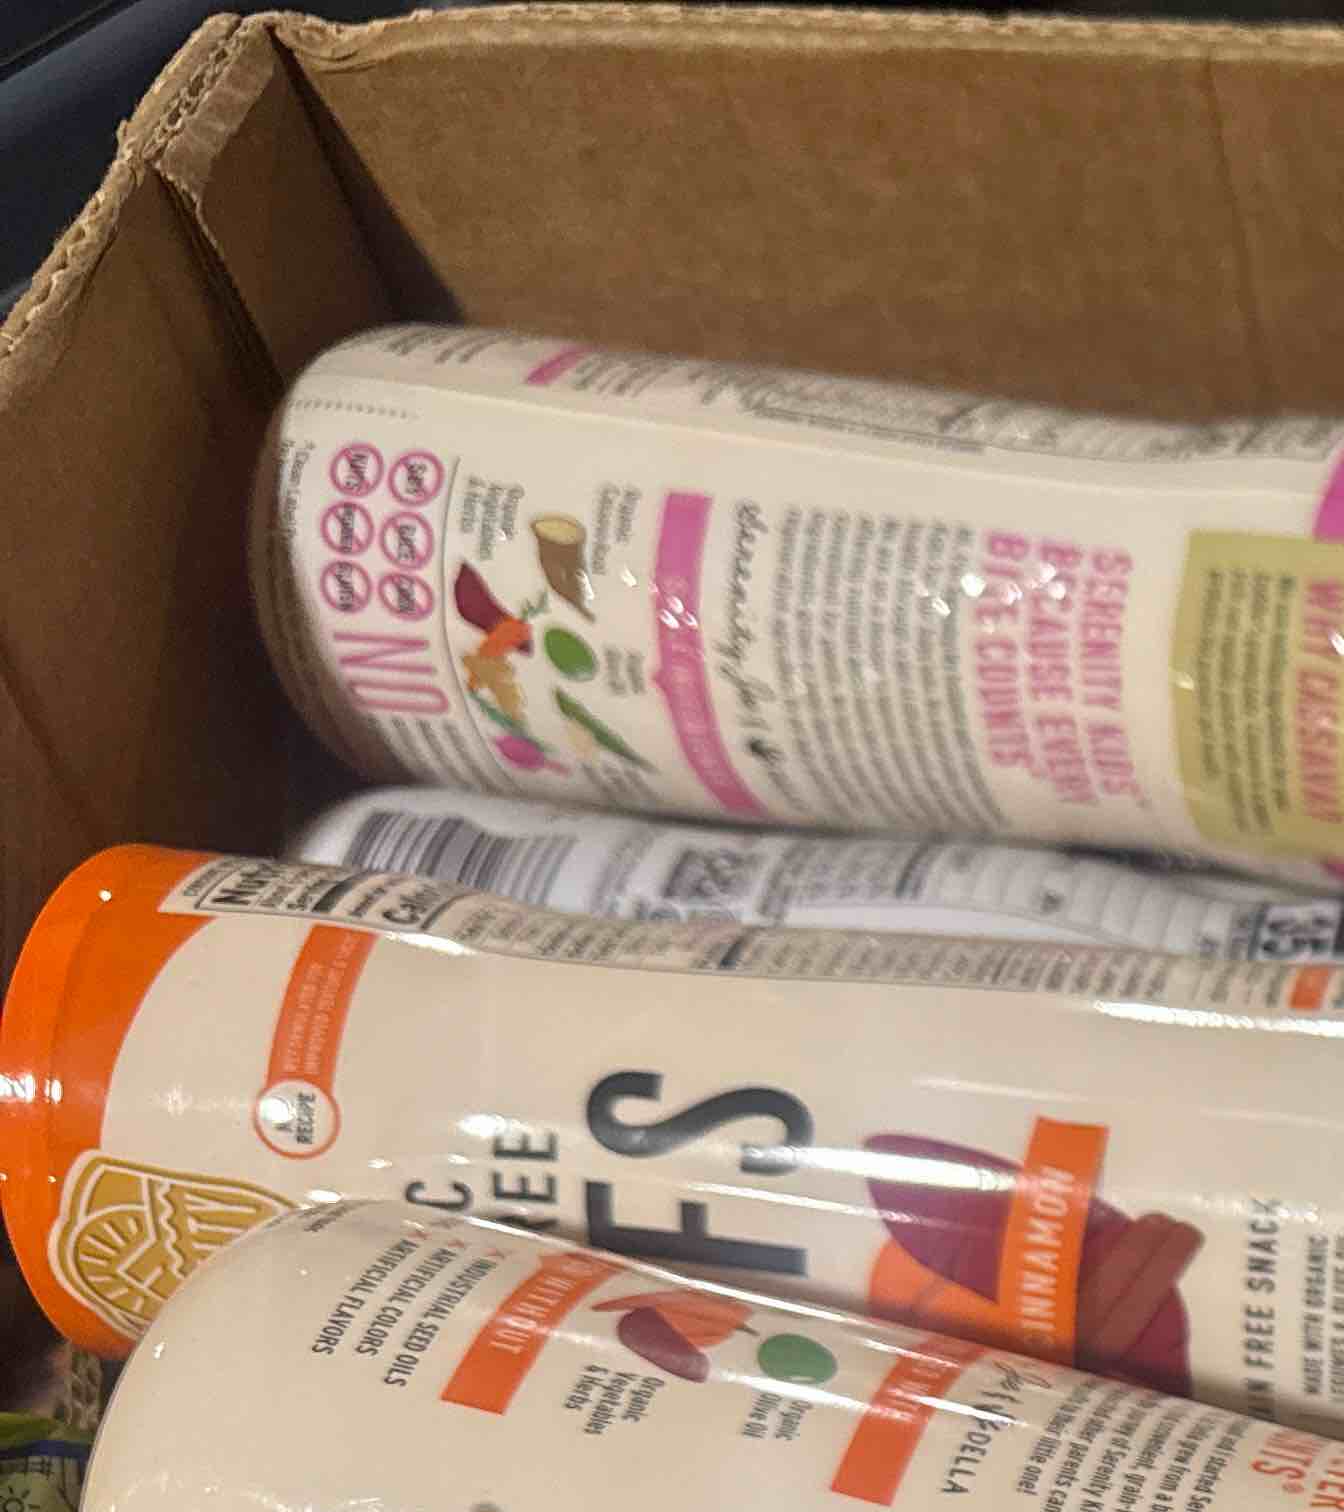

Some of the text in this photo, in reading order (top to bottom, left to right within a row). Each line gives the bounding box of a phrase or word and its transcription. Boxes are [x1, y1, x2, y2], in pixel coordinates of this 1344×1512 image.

[333, 632, 450, 716] NO
[1082, 550, 1134, 711] SERENITY
[1036, 714, 1097, 806] EVERY
[312, 1239, 417, 1354] ARTIFICIAL FLAVORS
[387, 1248, 455, 1304] ARTIFICIAL
[353, 1306, 397, 1355] COLORS
[383, 1259, 498, 1388] INDUSTRIAL SEED OILS
[1244, 1305, 1276, 1369] FREE
